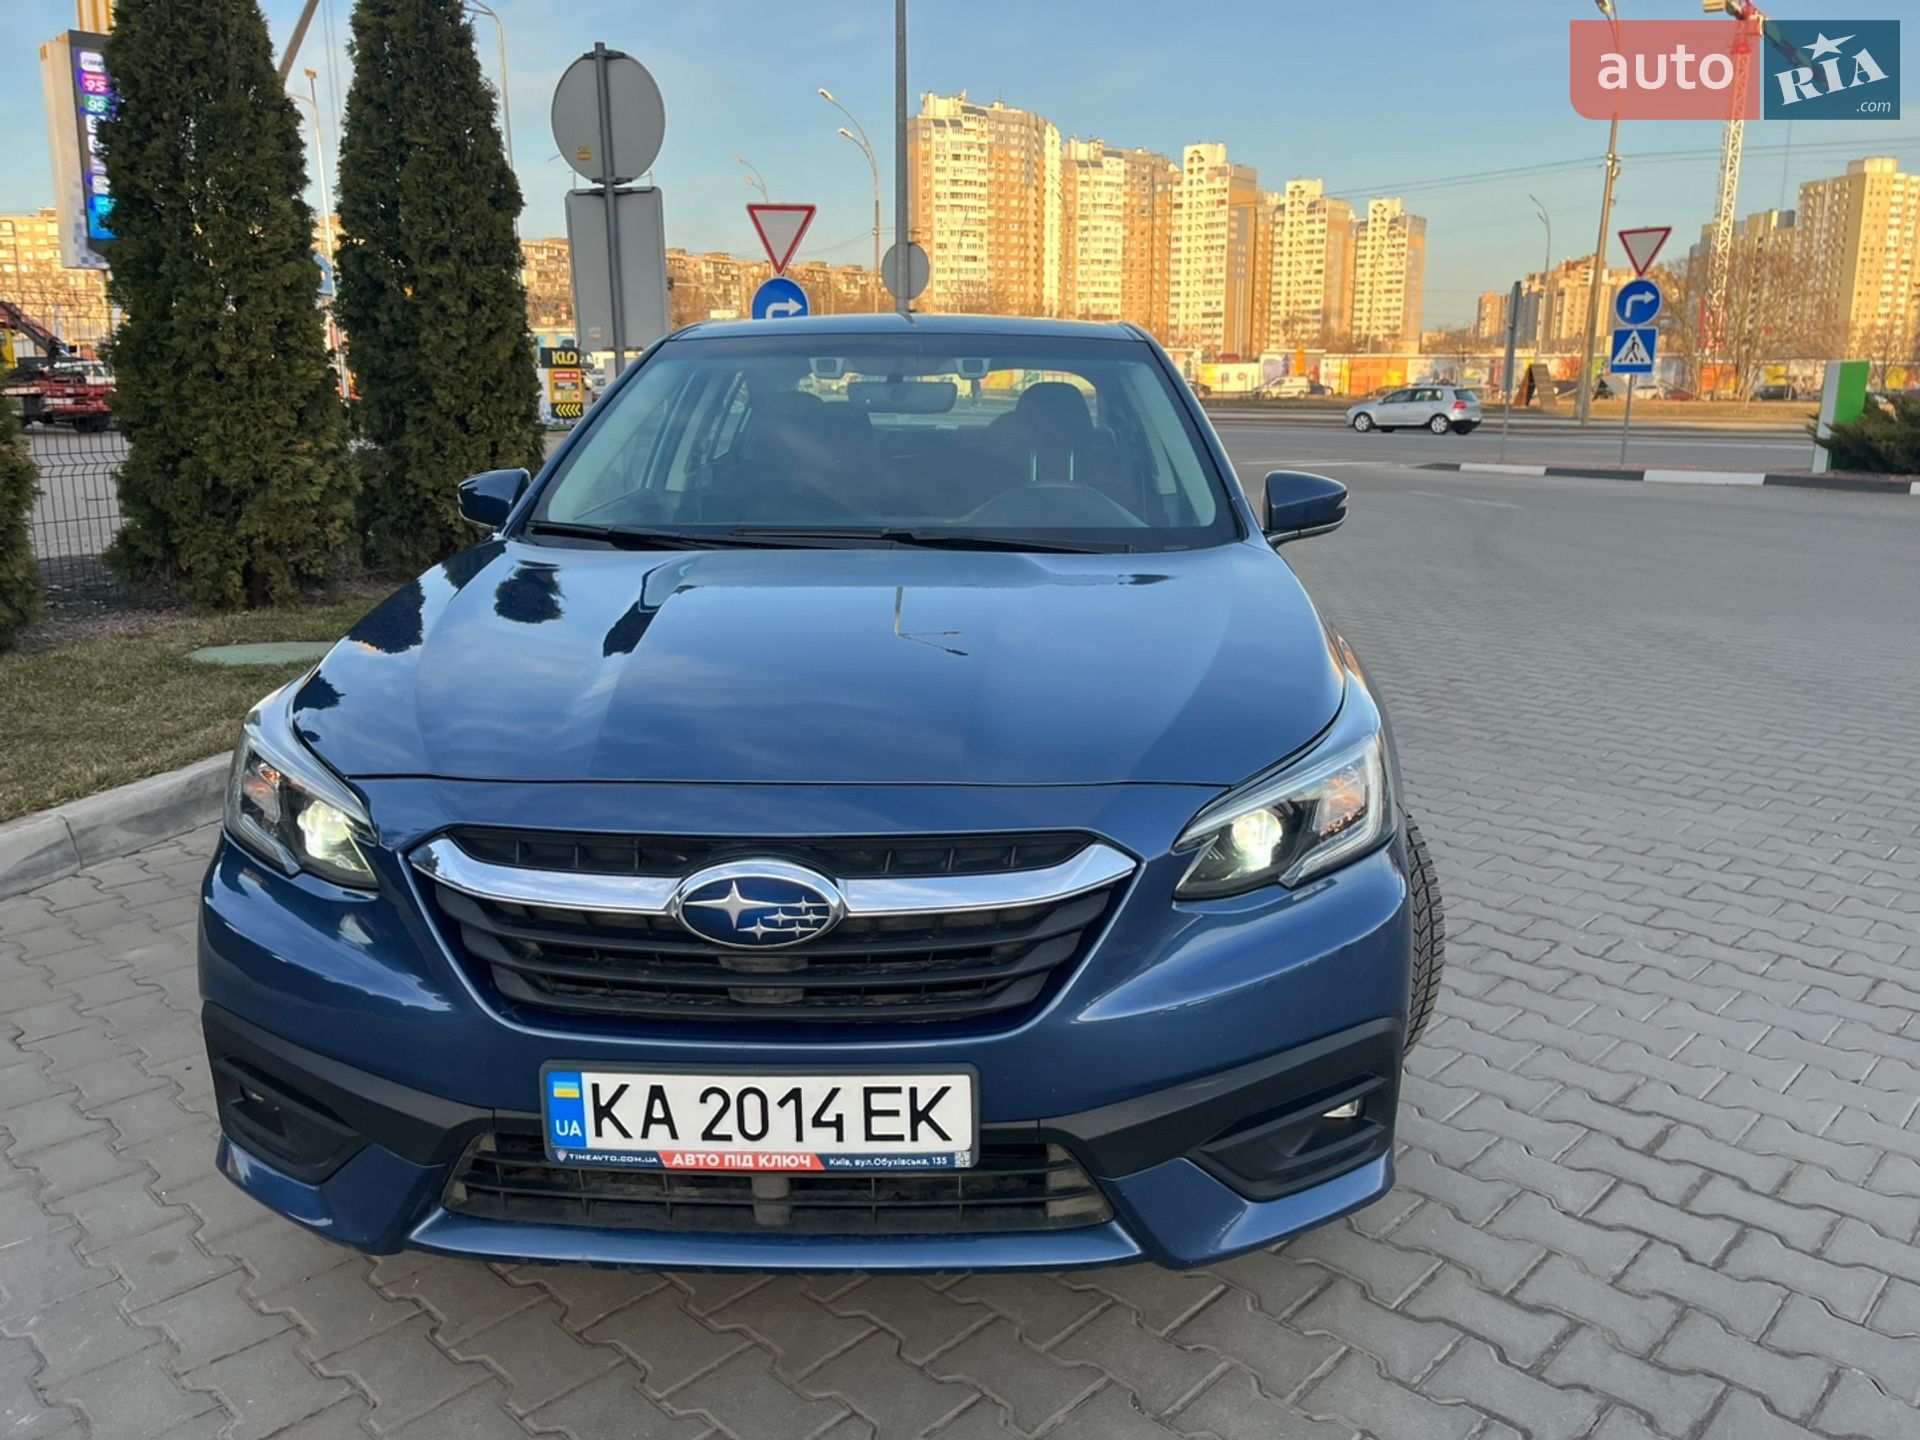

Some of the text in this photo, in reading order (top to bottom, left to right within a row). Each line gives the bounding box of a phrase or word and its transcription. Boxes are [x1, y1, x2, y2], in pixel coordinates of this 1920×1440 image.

[86, 80, 106, 92] 95
[88, 99, 106, 112] 95
[552, 351, 578, 365] KLO
[591, 1082, 953, 1143] KA 2014 EK
[555, 1120, 583, 1138] UA
[568, 1152, 659, 1163] TIMEAVTO.COM.UA
[672, 1153, 811, 1168] АВТО ПІД КЛЮЧ
[829, 1158, 853, 1167] Київ,
[931, 1156, 948, 1166] 135
